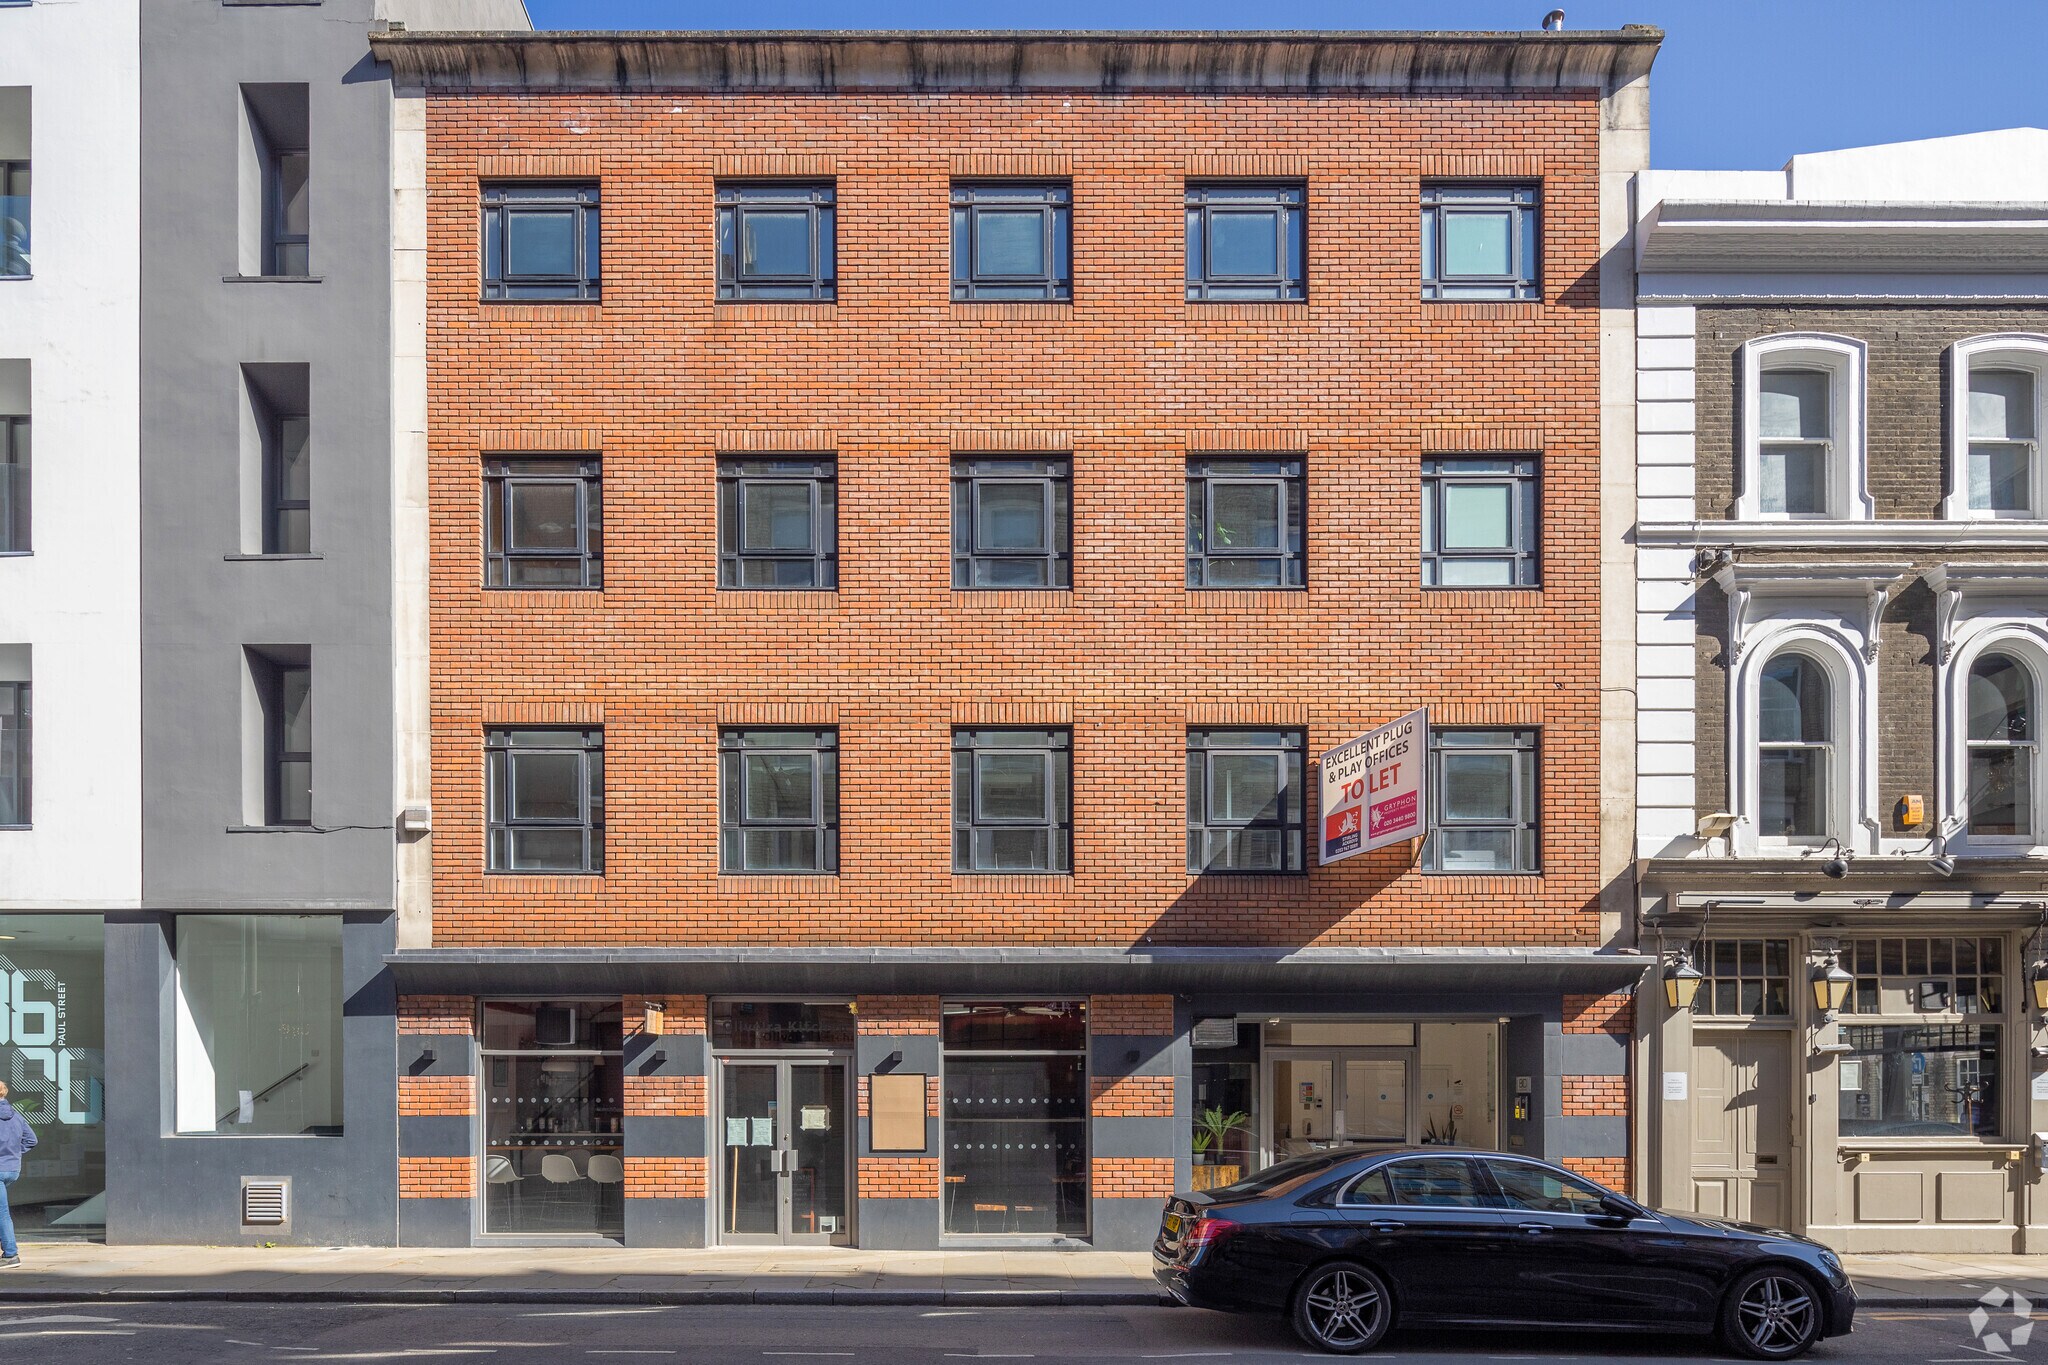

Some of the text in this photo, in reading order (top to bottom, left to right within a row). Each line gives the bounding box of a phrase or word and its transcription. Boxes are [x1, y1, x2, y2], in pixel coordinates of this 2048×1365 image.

[1325, 721, 1413, 770] EXCELLENT PLUG
[1328, 740, 1409, 784] & PLAY OFFICES
[1340, 762, 1402, 804] TO LET
[1384, 795, 1417, 811] GRYPHON
[0, 968, 56, 1046] 6
[57, 981, 66, 1046] PAUL STREET
